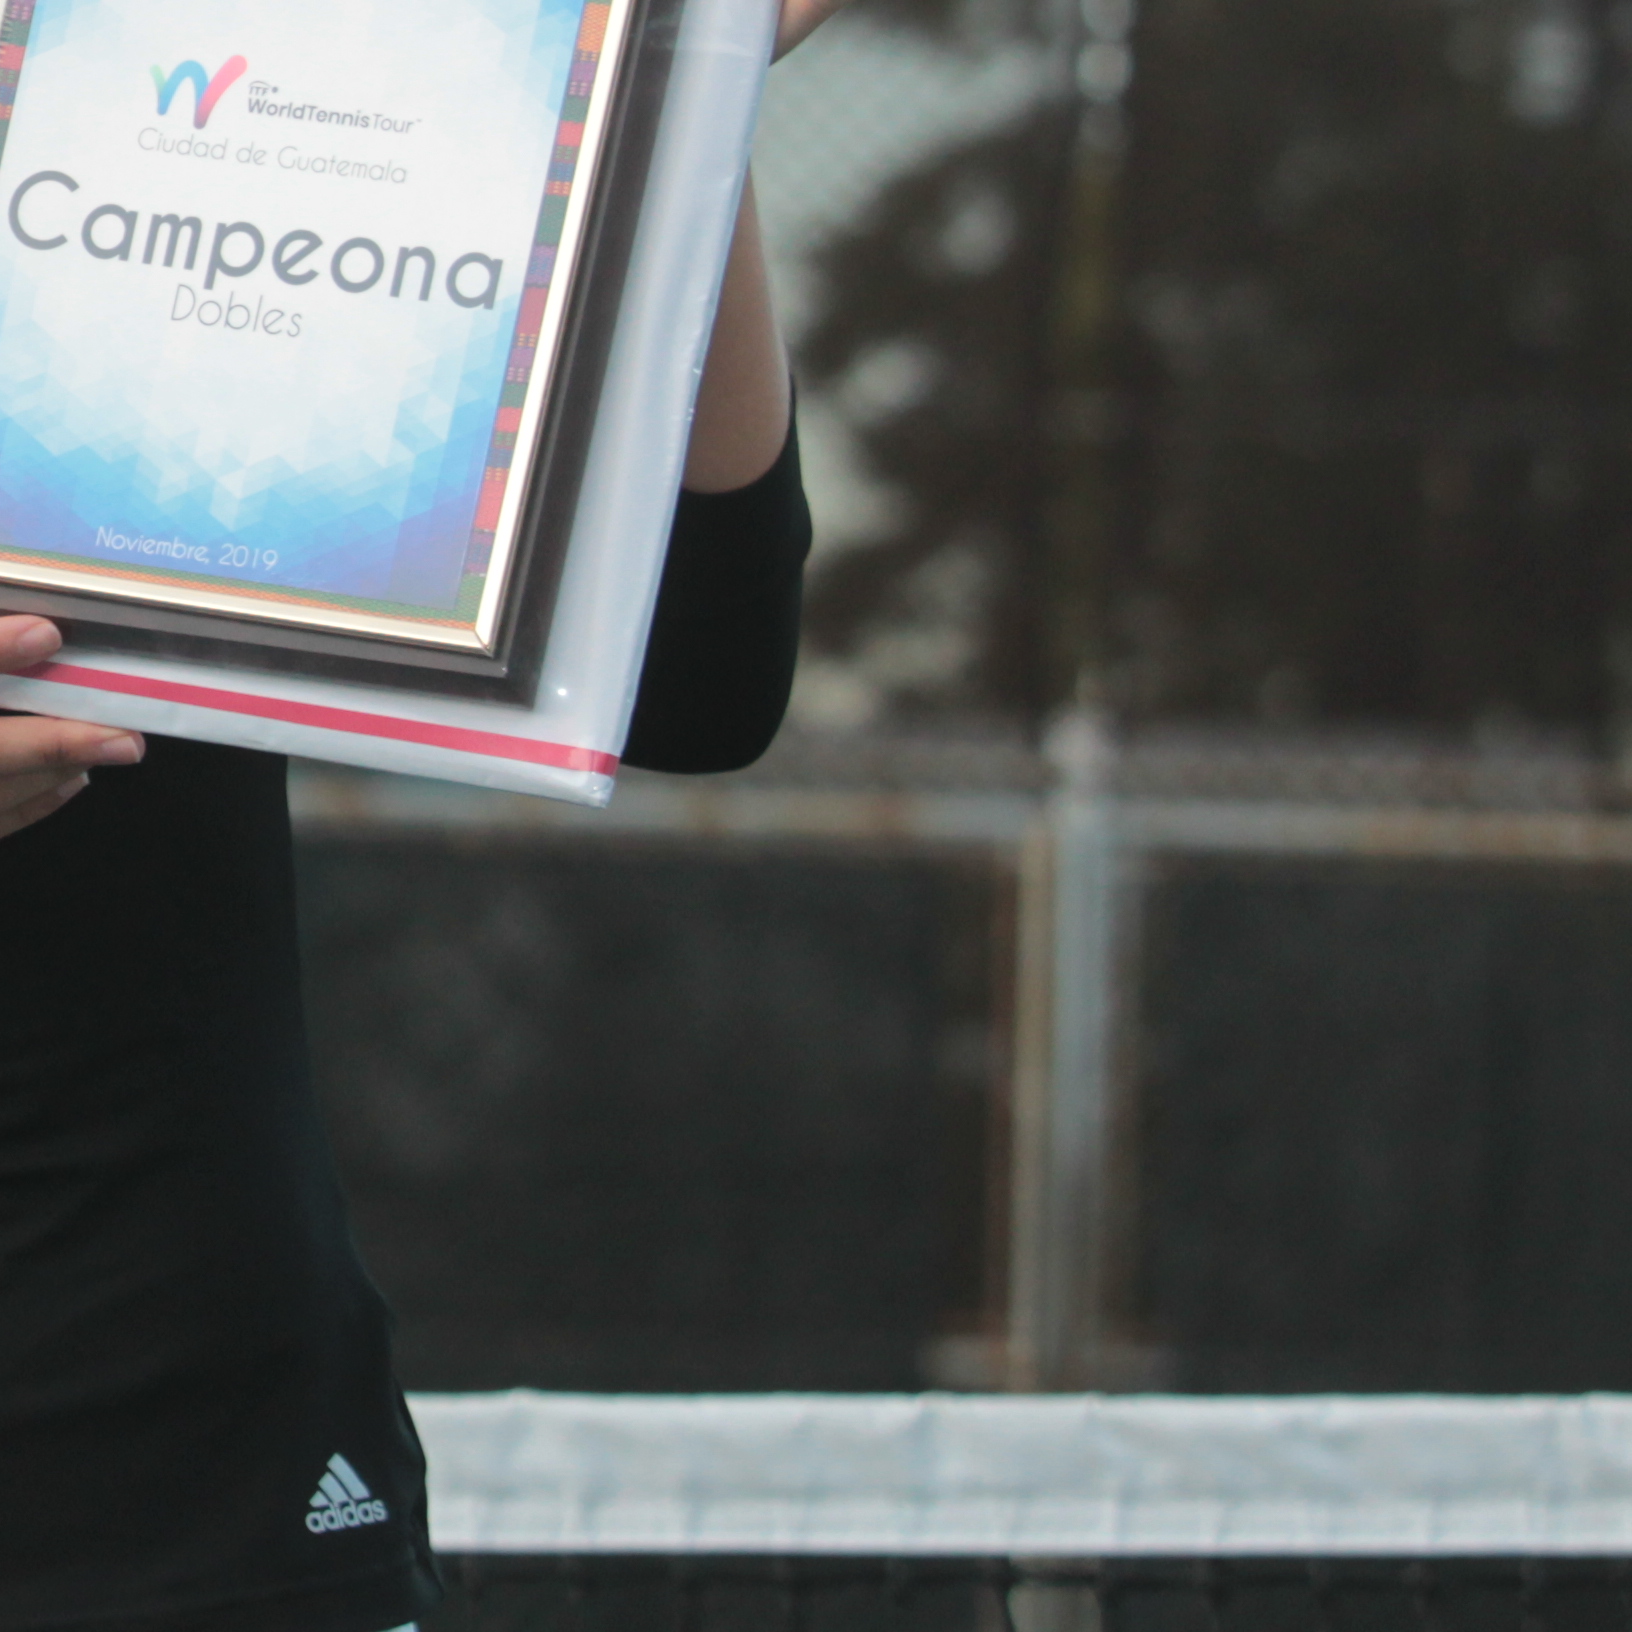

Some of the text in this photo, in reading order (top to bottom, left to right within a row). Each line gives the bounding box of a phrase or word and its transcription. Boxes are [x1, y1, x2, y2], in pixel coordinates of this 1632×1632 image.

[137, 127, 408, 184] Ciudad de Guatemala
[8, 170, 504, 310] Campeona
[170, 284, 303, 338] Dobles
[96, 526, 278, 571] Noviembre, 2019
[305, 1499, 389, 1534] adidas
